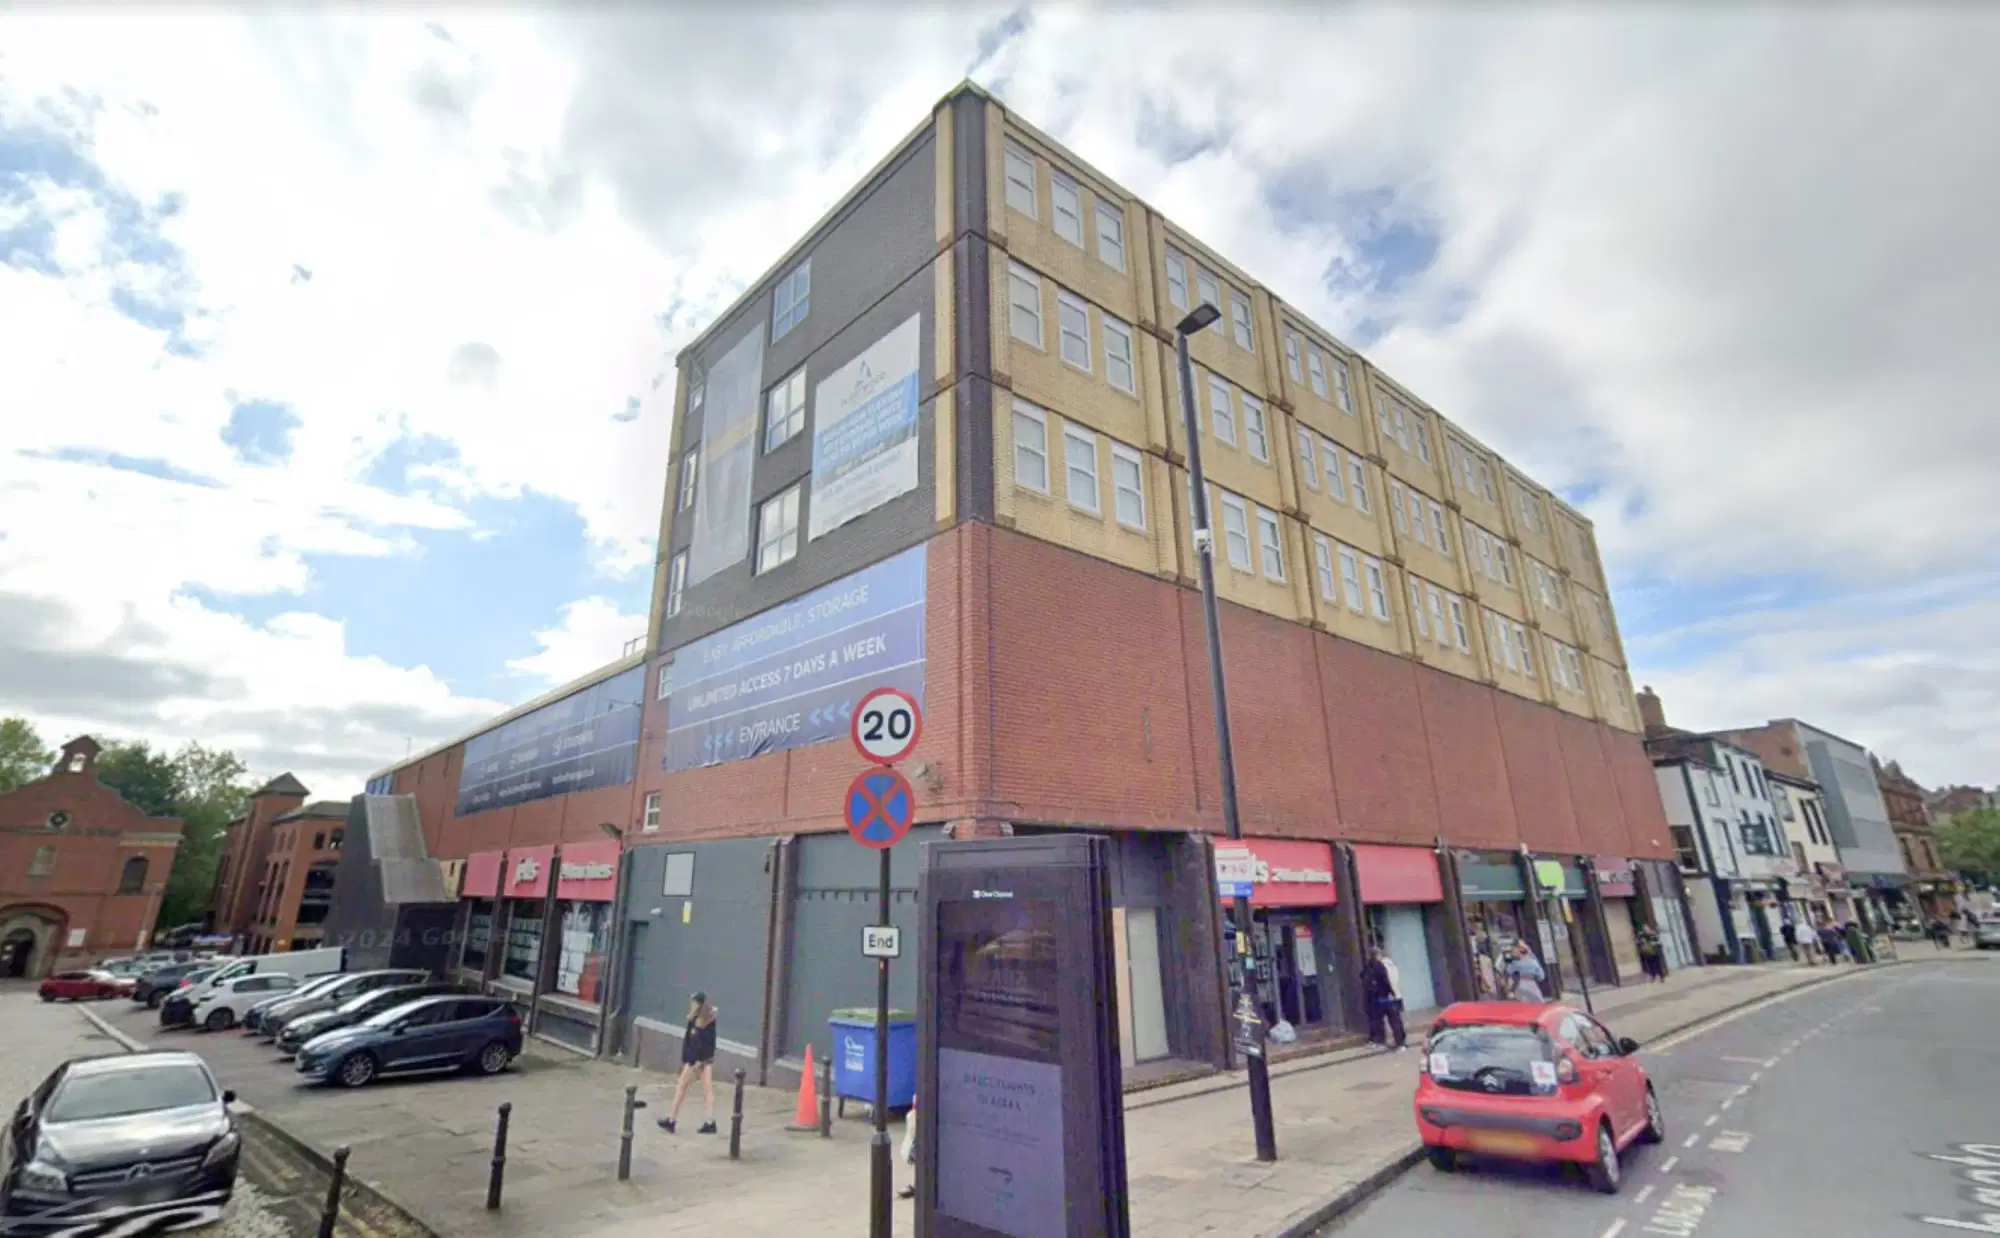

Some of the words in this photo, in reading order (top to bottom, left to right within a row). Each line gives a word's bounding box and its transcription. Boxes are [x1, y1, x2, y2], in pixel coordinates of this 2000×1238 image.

[807, 584, 870, 624] STORAGE
[738, 668, 781, 696] ACCESS
[783, 665, 793, 684] 7
[793, 654, 827, 679] DAYS
[829, 650, 839, 669] A
[842, 632, 887, 663] WEEK
[739, 713, 801, 744] ENTRANCE
[862, 708, 912, 741] 20
[868, 933, 894, 950] End
